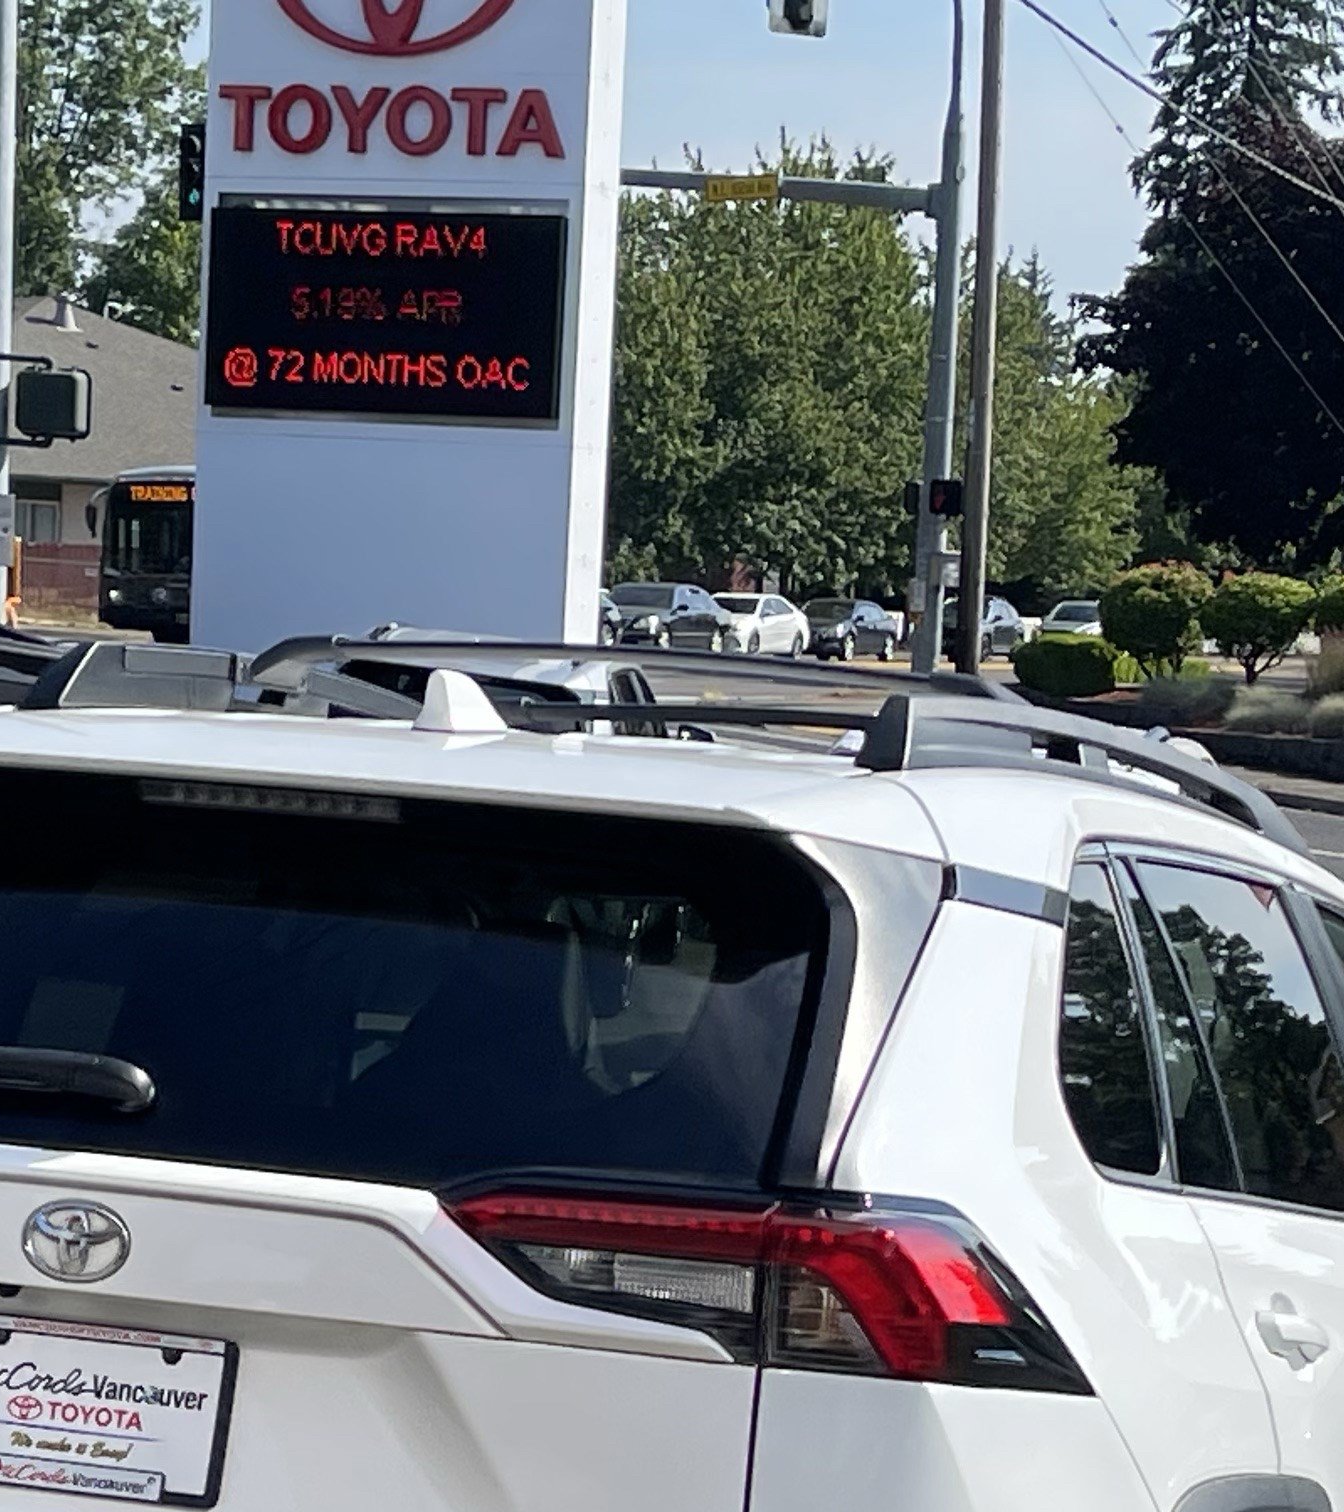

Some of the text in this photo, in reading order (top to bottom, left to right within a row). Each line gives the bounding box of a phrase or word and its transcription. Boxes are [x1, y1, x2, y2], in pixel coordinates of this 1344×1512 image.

[218, 83, 566, 158] TOYOTA
[394, 223, 487, 259] RAV4
[397, 288, 464, 325] APR
[223, 347, 531, 391] @ 72 MONTHS OAC
[47, 1400, 143, 1431] TOYOTA
